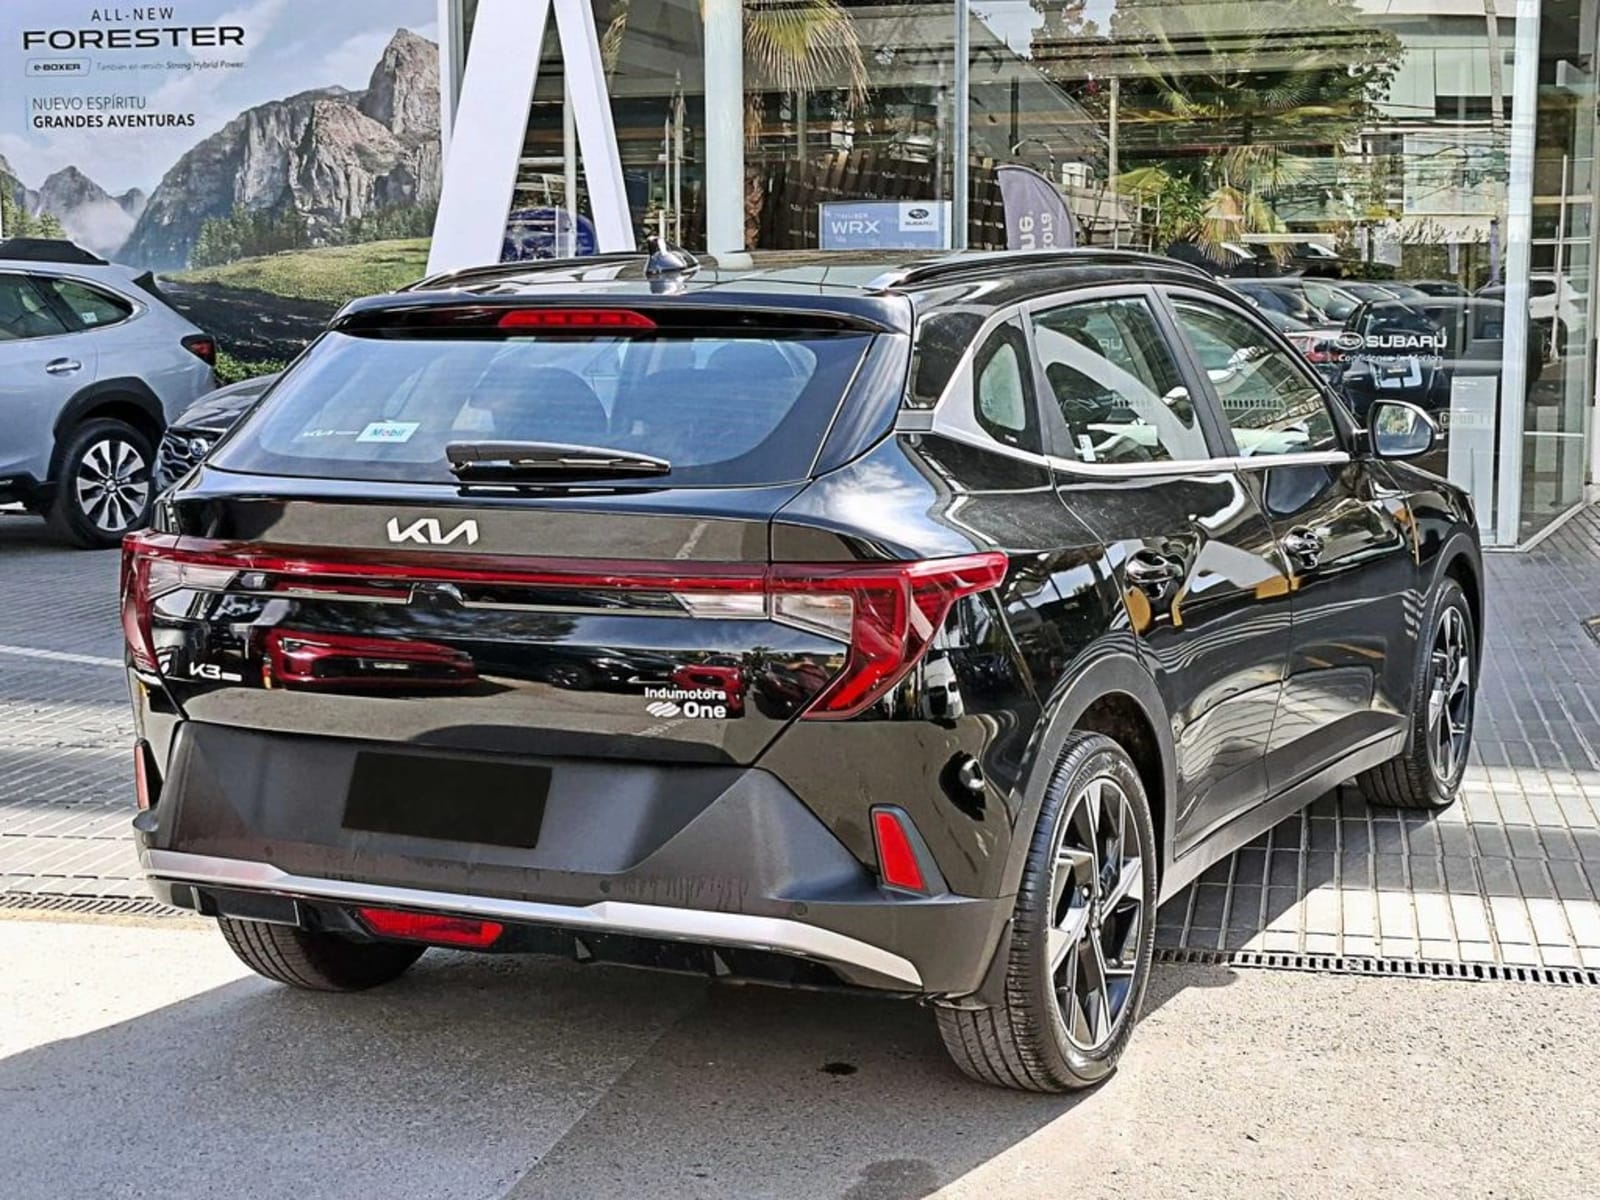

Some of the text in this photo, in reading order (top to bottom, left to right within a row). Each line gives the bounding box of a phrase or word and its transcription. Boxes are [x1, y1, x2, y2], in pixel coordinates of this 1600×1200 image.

[91, 7, 175, 21] ALL-NEW
[23, 26, 245, 50] FORESTER
[32, 93, 146, 111] NUEVO ESPÍRITU
[33, 113, 195, 128] GRANDES AVENTURAS
[831, 221, 880, 234] WRX
[1366, 335, 1447, 348] SUBARU
[387, 517, 479, 545] KIA
[189, 661, 220, 680] K3
[644, 687, 727, 700] Indumotora
[683, 701, 727, 718] One
